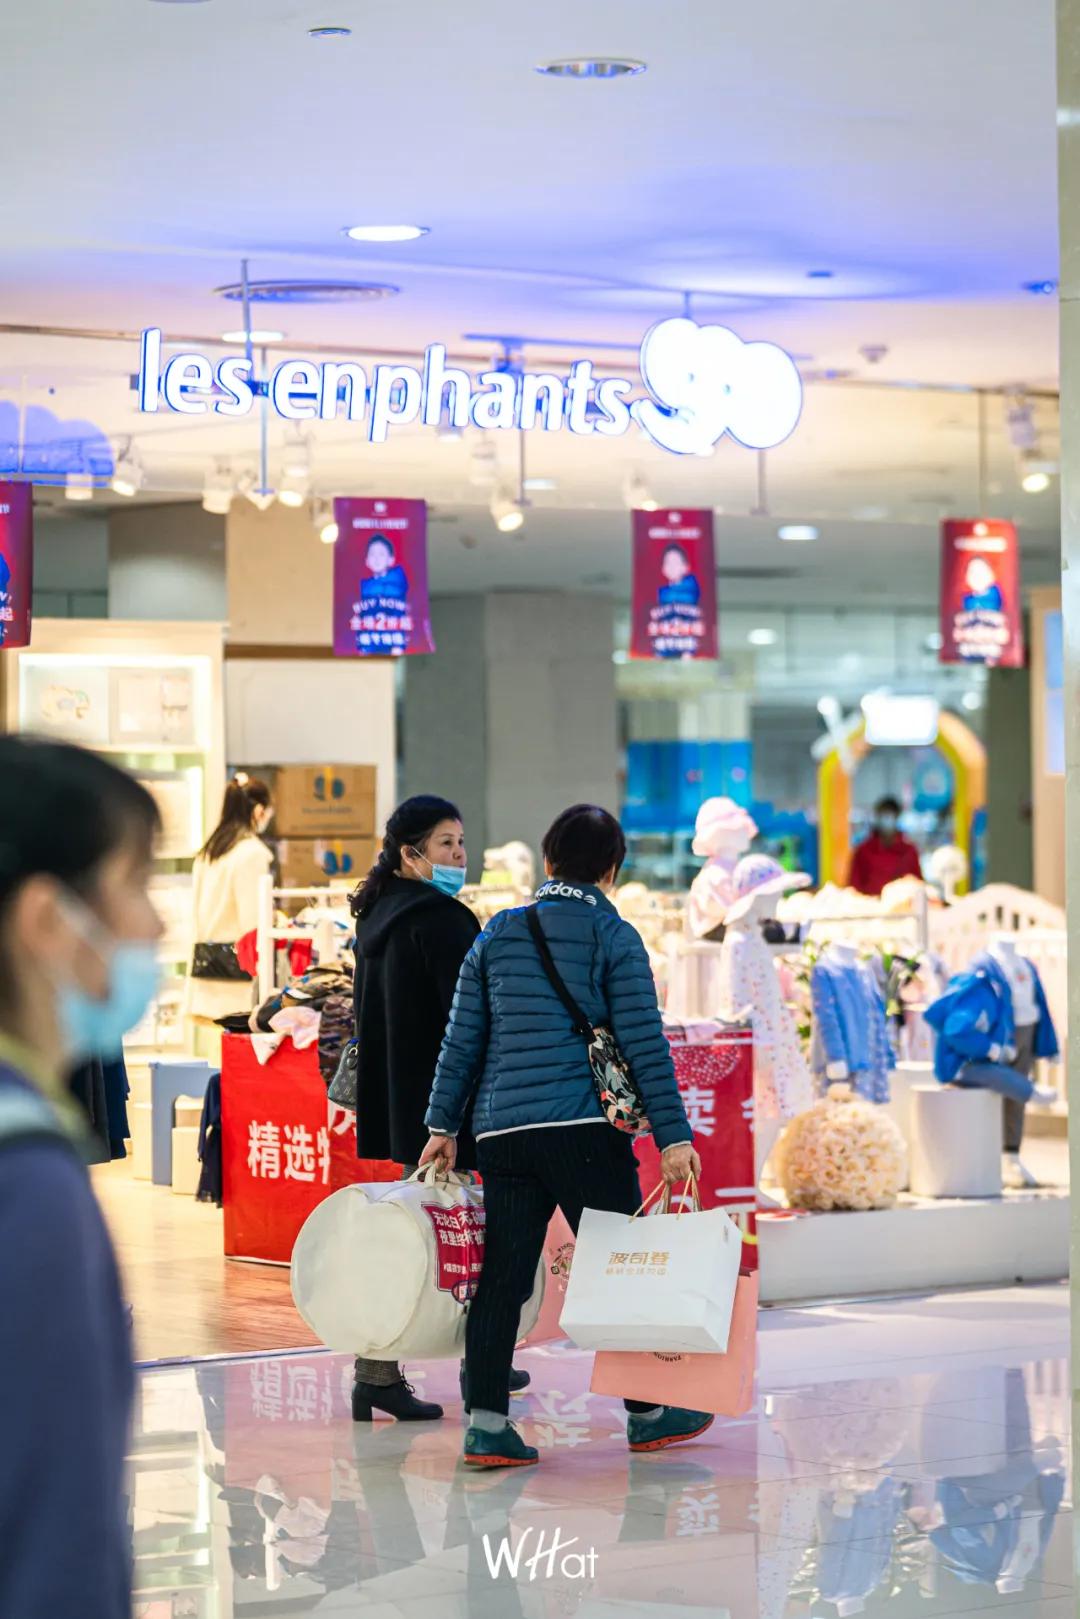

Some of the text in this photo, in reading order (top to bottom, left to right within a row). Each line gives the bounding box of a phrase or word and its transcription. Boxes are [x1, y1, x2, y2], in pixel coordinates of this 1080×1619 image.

[139, 327, 633, 443] les enphants
[352, 598, 377, 614] BUY
[534, 882, 583, 899] didas
[608, 1251, 670, 1266] 波司登
